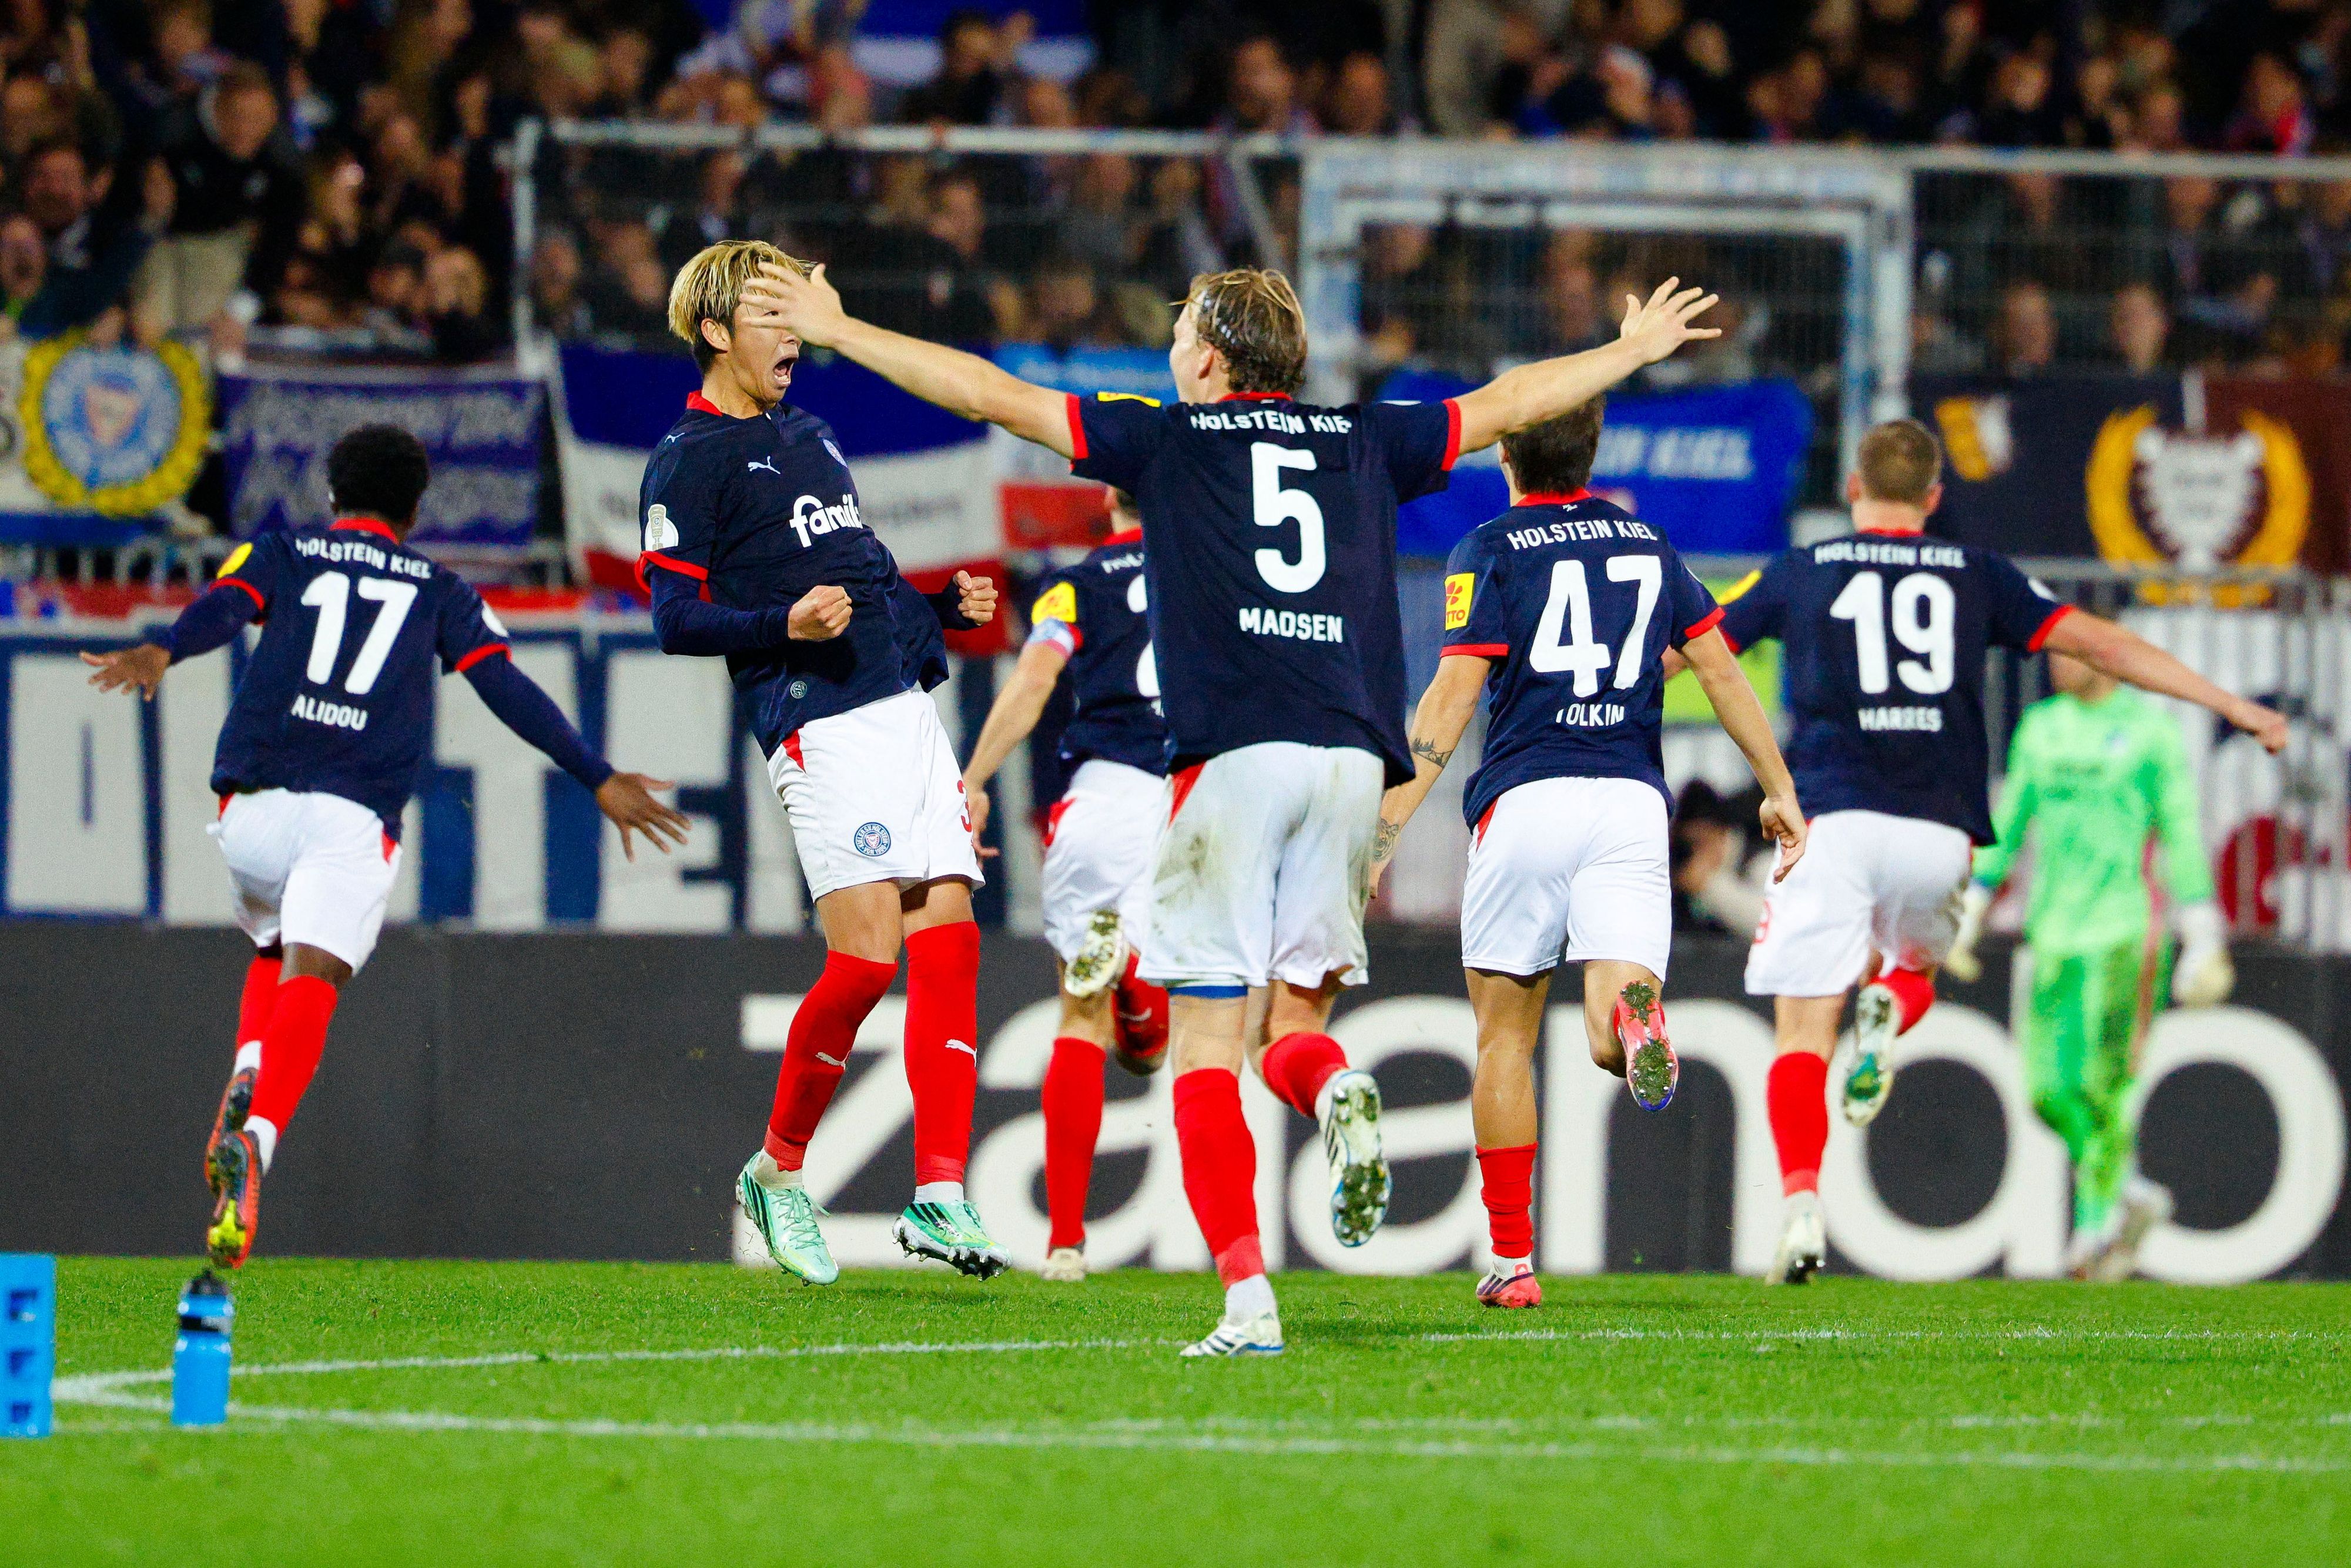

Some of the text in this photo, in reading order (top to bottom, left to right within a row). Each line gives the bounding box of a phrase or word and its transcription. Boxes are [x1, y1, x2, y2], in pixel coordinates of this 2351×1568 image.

[1190, 410, 1306, 435] HOLSTEIN
[789, 494, 864, 548] famil
[1250, 441, 1327, 594] 5
[1506, 520, 1657, 550] HOLSTEIN KIEL
[295, 537, 432, 579] HOLSTEIN KIEL
[1814, 541, 1967, 569] HOLSTEIN KIEL
[300, 570, 418, 695] 17
[1238, 607, 1344, 644] MADSEN
[1529, 555, 1663, 698] 47
[1828, 569, 1956, 695] 19
[290, 693, 369, 731] ALIDOU
[1857, 705, 1943, 733] HARRES
[872, 824, 889, 845] HOLSTEIN
[732, 943, 2348, 1285] zaando
